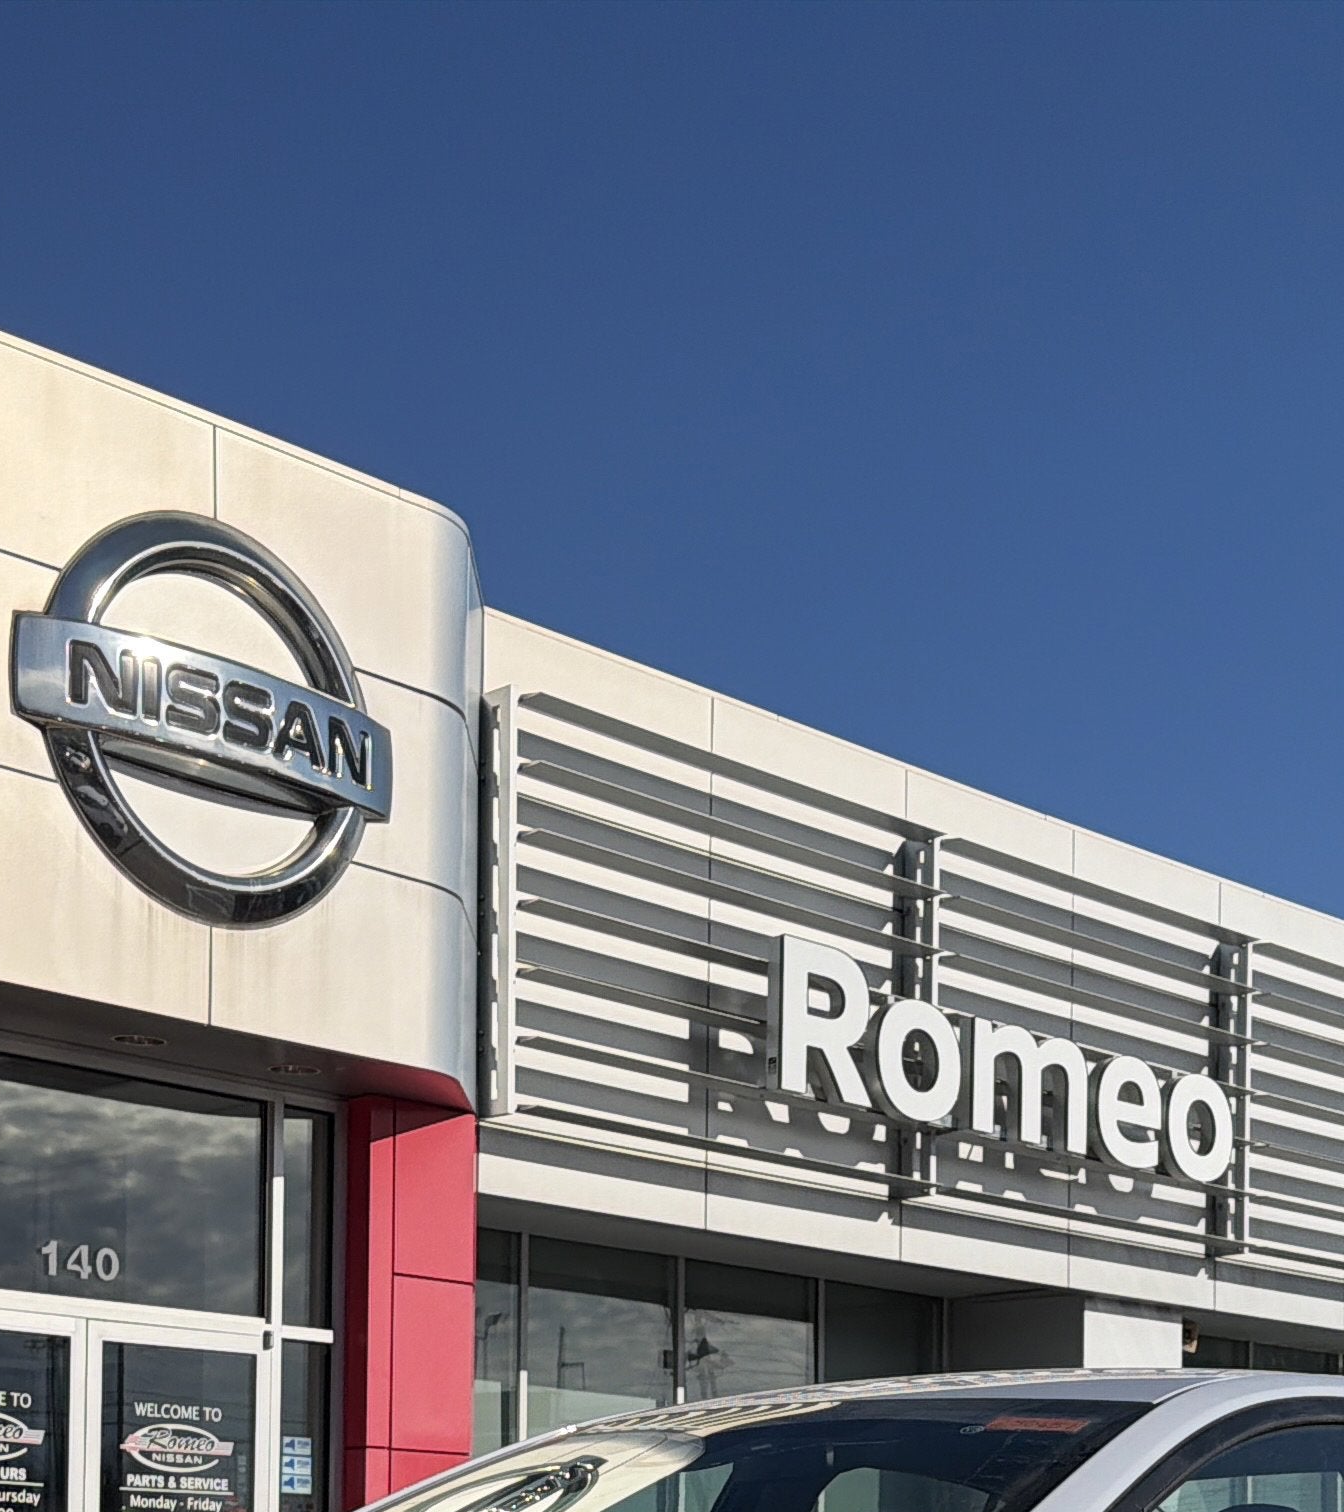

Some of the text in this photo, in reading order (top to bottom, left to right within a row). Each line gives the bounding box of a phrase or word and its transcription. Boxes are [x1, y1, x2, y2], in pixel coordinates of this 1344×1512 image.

[66, 638, 374, 792] NISSAN
[770, 933, 1233, 1184] Romeo
[41, 1239, 120, 1282] 140
[10, 1391, 32, 1409] TO
[134, 1401, 222, 1423] WELCOME TO
[146, 1426, 216, 1452] Romeo
[152, 1452, 203, 1465] NISSAN
[126, 1473, 229, 1491] PARTS & SERVICE
[129, 1493, 177, 1512] Monday
